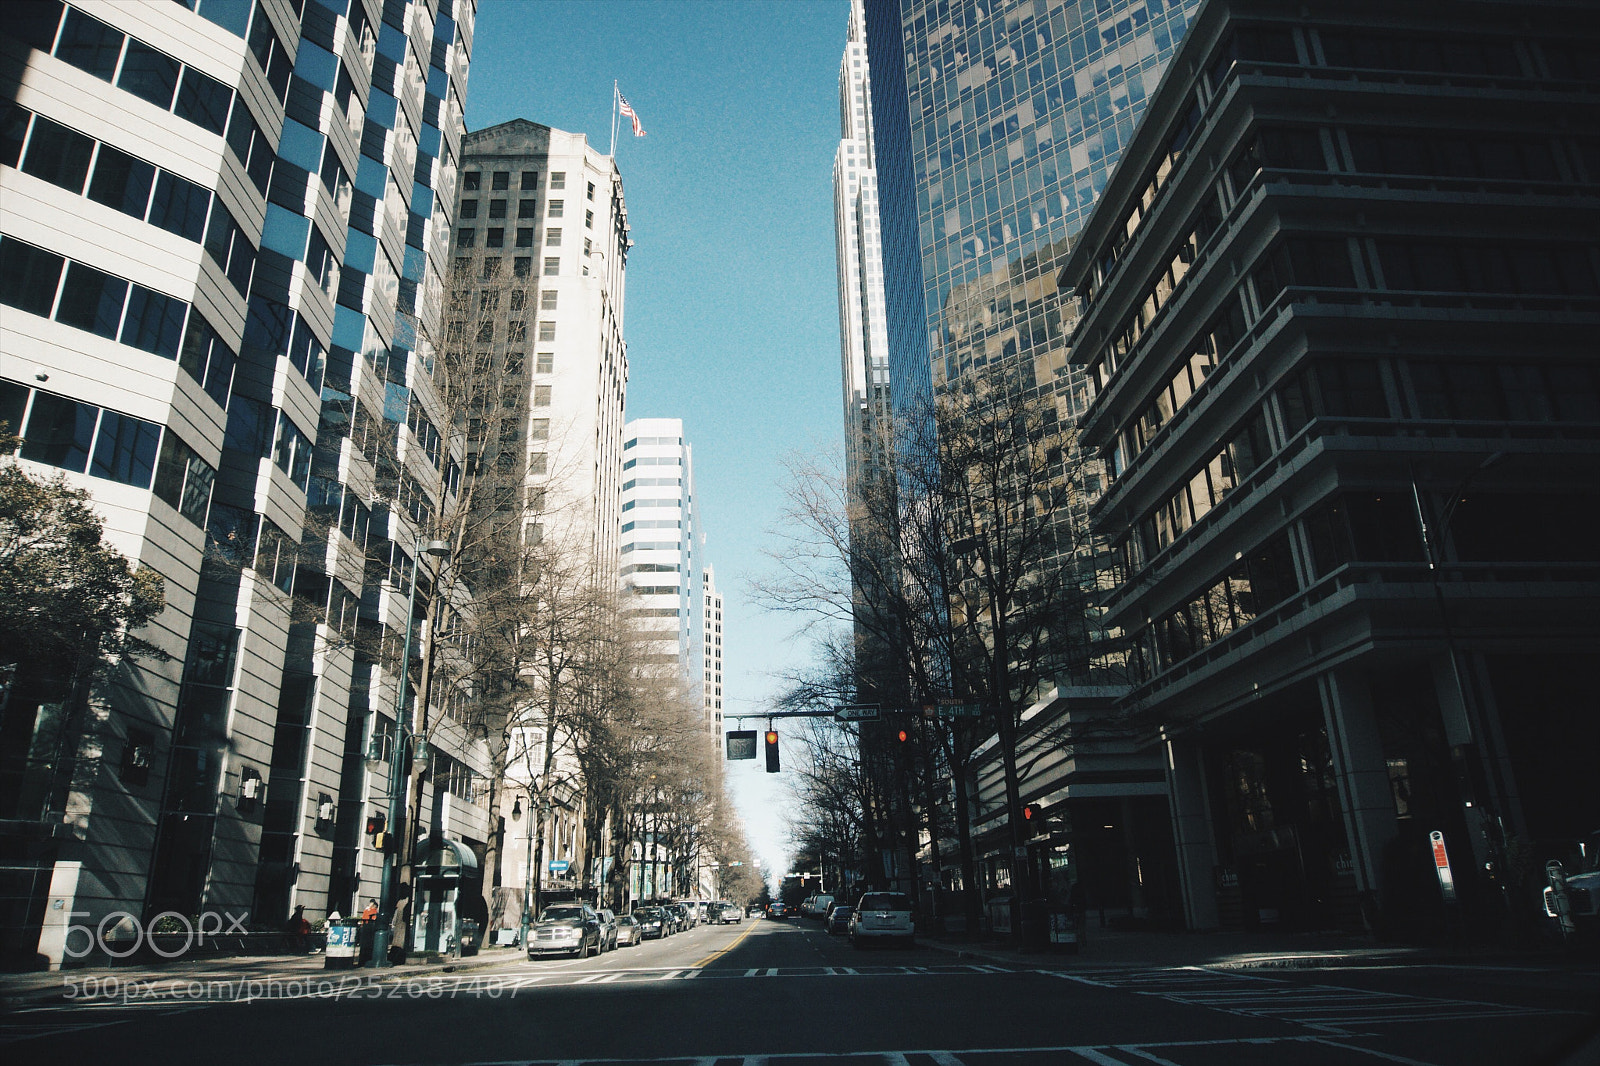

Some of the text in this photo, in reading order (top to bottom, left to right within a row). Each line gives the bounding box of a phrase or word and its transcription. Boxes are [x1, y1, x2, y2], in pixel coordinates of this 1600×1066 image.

[847, 708, 875, 717] ONE WAY
[949, 705, 965, 715] 4TH
